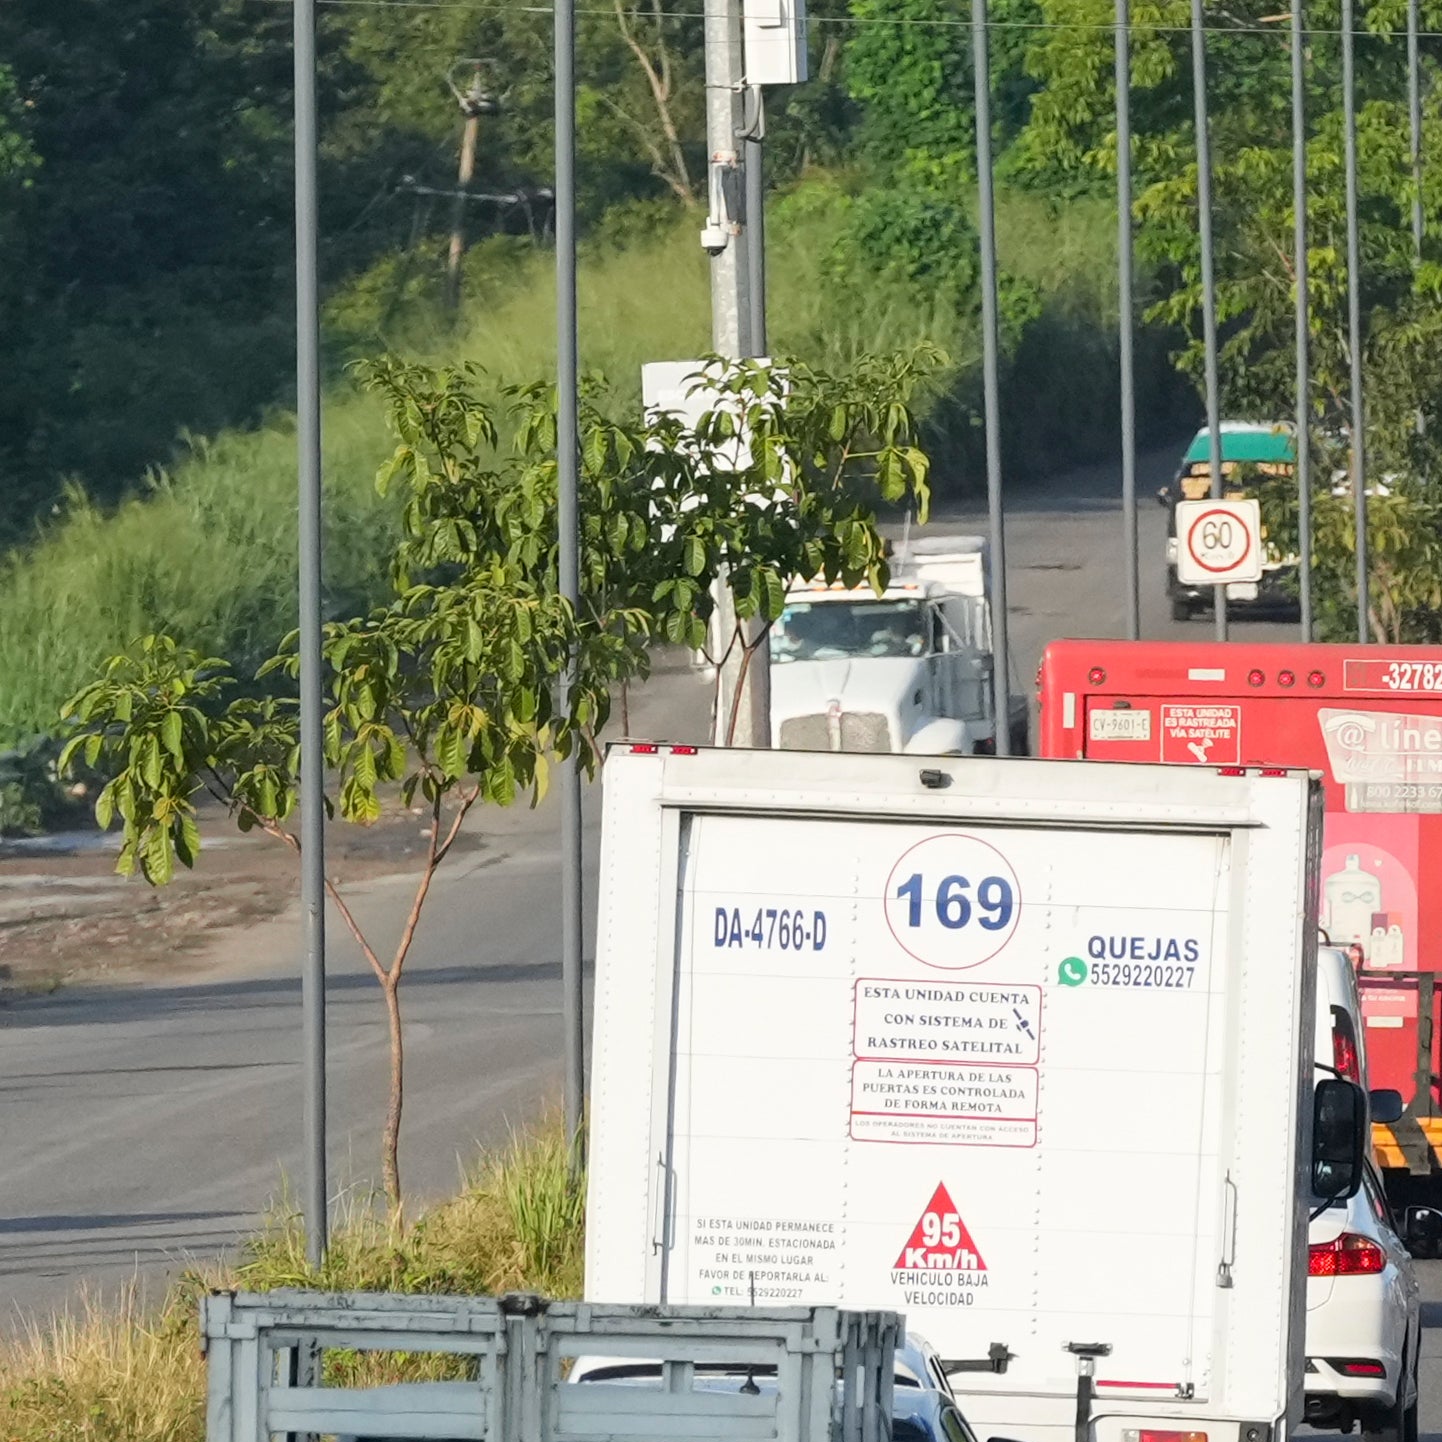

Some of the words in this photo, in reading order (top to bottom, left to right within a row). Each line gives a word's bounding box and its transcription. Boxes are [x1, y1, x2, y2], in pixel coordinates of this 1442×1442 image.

[1203, 521, 1233, 549] 60
[1170, 708, 1194, 718] ESTA
[1196, 709, 1232, 718] UNIDAD
[1093, 718, 1148, 732] CV-9601-E
[1165, 717, 1178, 727] ES
[1179, 718, 1236, 728] RASTREADA
[897, 873, 1013, 931] 169
[714, 907, 827, 951] DA-4766-D
[1088, 935, 1200, 963] QUEJAS
[1090, 963, 1195, 989] 5529220227
[864, 987, 901, 999] ESTA
[905, 988, 965, 1002] UNIDAD
[969, 991, 1030, 1005] CUENTA
[884, 1013, 915, 1026] CON
[918, 1014, 983, 1028] SISTEMA
[988, 1017, 1008, 1029] DE
[867, 1036, 938, 1050] RASTREO
[941, 1039, 1023, 1054] SATELITAL
[878, 1068, 893, 1078] LA
[897, 1069, 965, 1082] APERTURA
[969, 1072, 985, 1082] DE
[988, 1073, 1012, 1083] LAS
[863, 1083, 920, 1095] PUERTAS
[922, 1084, 937, 1095] ES
[940, 1085, 1026, 1099] CONTROLADA
[884, 1098, 901, 1108] DE
[904, 1099, 948, 1111] FORMA
[951, 1101, 1002, 1113] REMOTA
[872, 1120, 924, 1129] OPERADORES
[940, 1123, 977, 1131] CUENTAN
[951, 1133, 993, 1141] APERTURA
[696, 1218, 706, 1229] SI
[709, 1219, 733, 1230] ESTA
[736, 1220, 772, 1231] UNIDAD
[775, 1221, 835, 1233] PERMANECE
[922, 1211, 961, 1248] 95
[694, 1235, 715, 1246] MAS
[718, 1236, 730, 1246] DE
[768, 1238, 836, 1250] ESTACIONADA
[715, 1253, 729, 1263] EN
[731, 1253, 743, 1263] EL
[746, 1254, 778, 1264] MISMO
[780, 1255, 814, 1265] LUGAR
[905, 1247, 978, 1269] Km/h
[699, 1269, 729, 1280] FAVOR
[733, 1270, 745, 1280] DE
[891, 1271, 953, 1287] VEHICULO
[958, 1272, 989, 1287] BAJA
[724, 1286, 744, 1296] TEL:
[904, 1291, 974, 1306] VELOCIDAD
